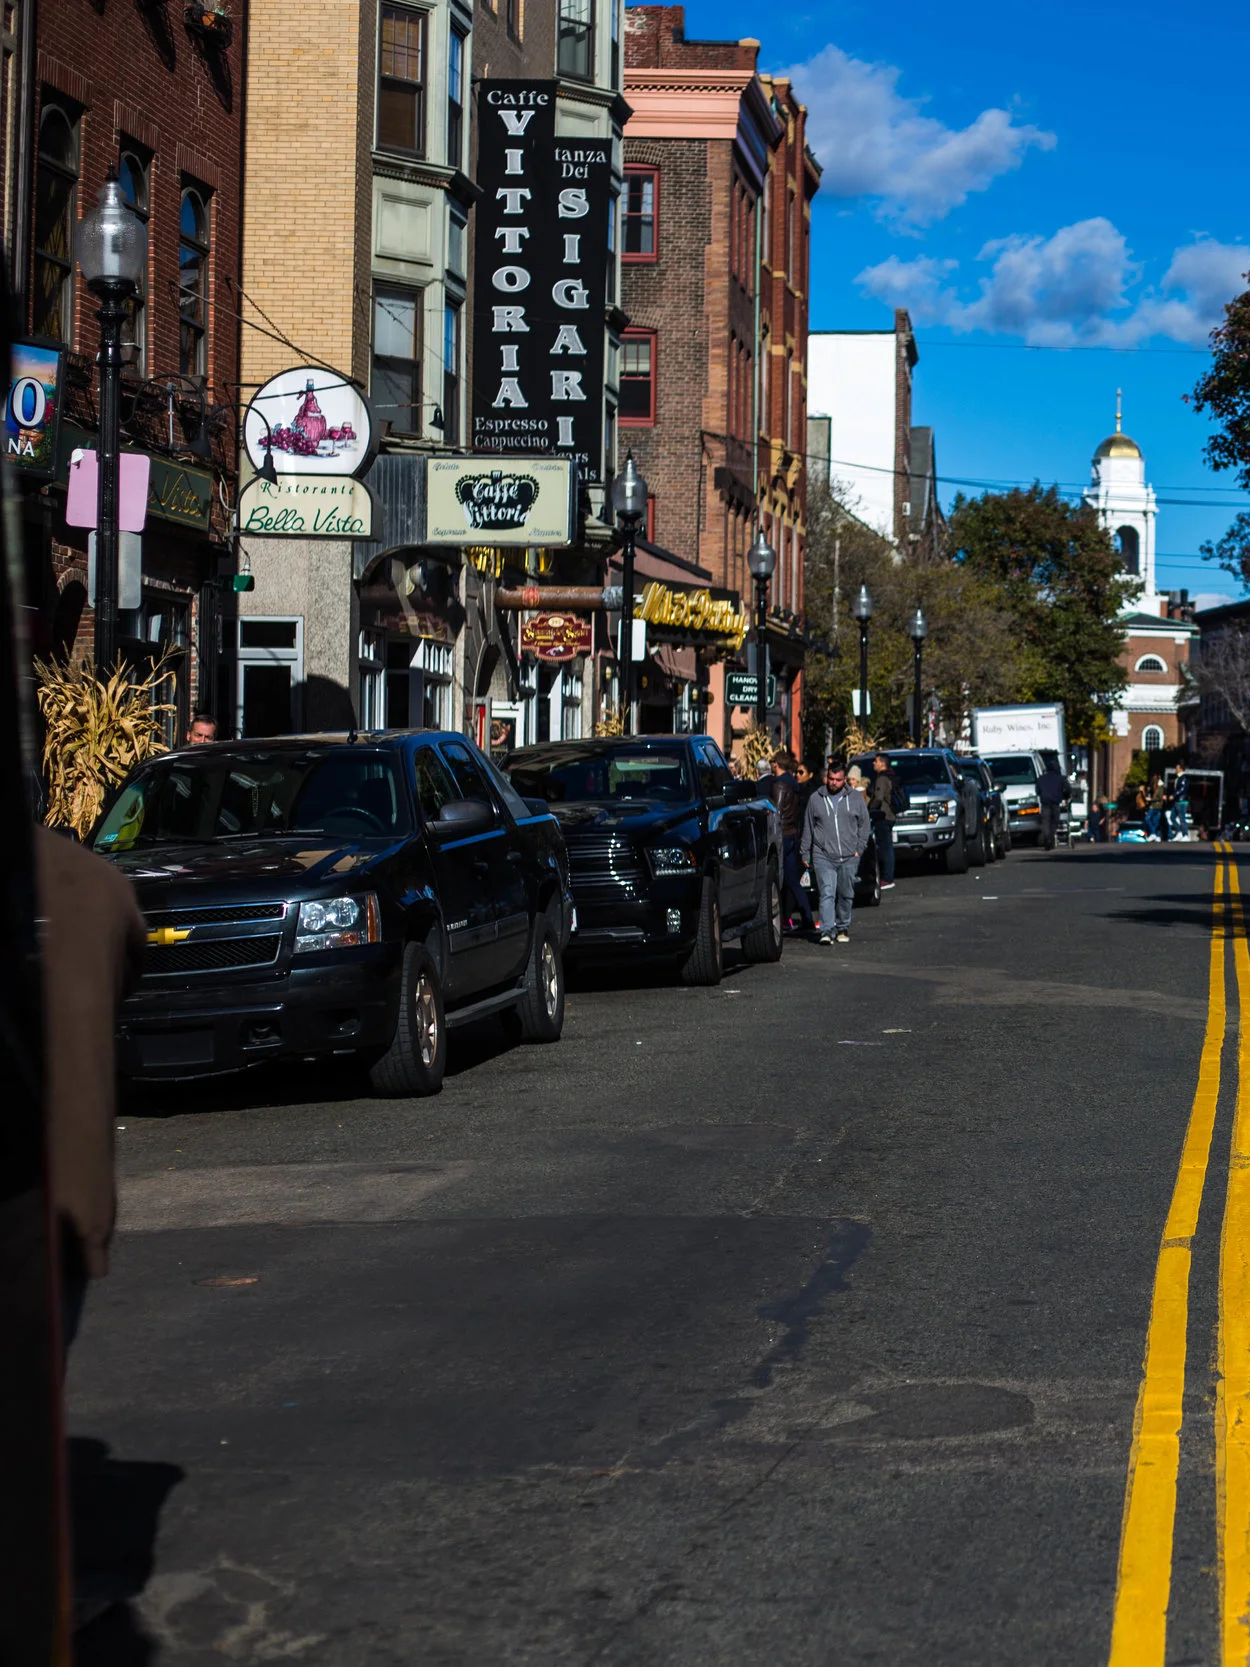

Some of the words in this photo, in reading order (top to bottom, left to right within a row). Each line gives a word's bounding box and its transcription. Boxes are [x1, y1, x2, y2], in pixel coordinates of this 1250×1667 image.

[487, 91, 549, 106] Caffe
[554, 147, 607, 163] tanza
[561, 163, 590, 179] Dei
[491, 110, 537, 408] VITTORIA
[549, 188, 590, 446] SIGARI
[475, 417, 549, 432] Espresso
[474, 434, 549, 450] Cappuccino
[260, 481, 354, 499] Ristorante
[246, 506, 306, 532] Bella
[313, 506, 366, 534] Vista
